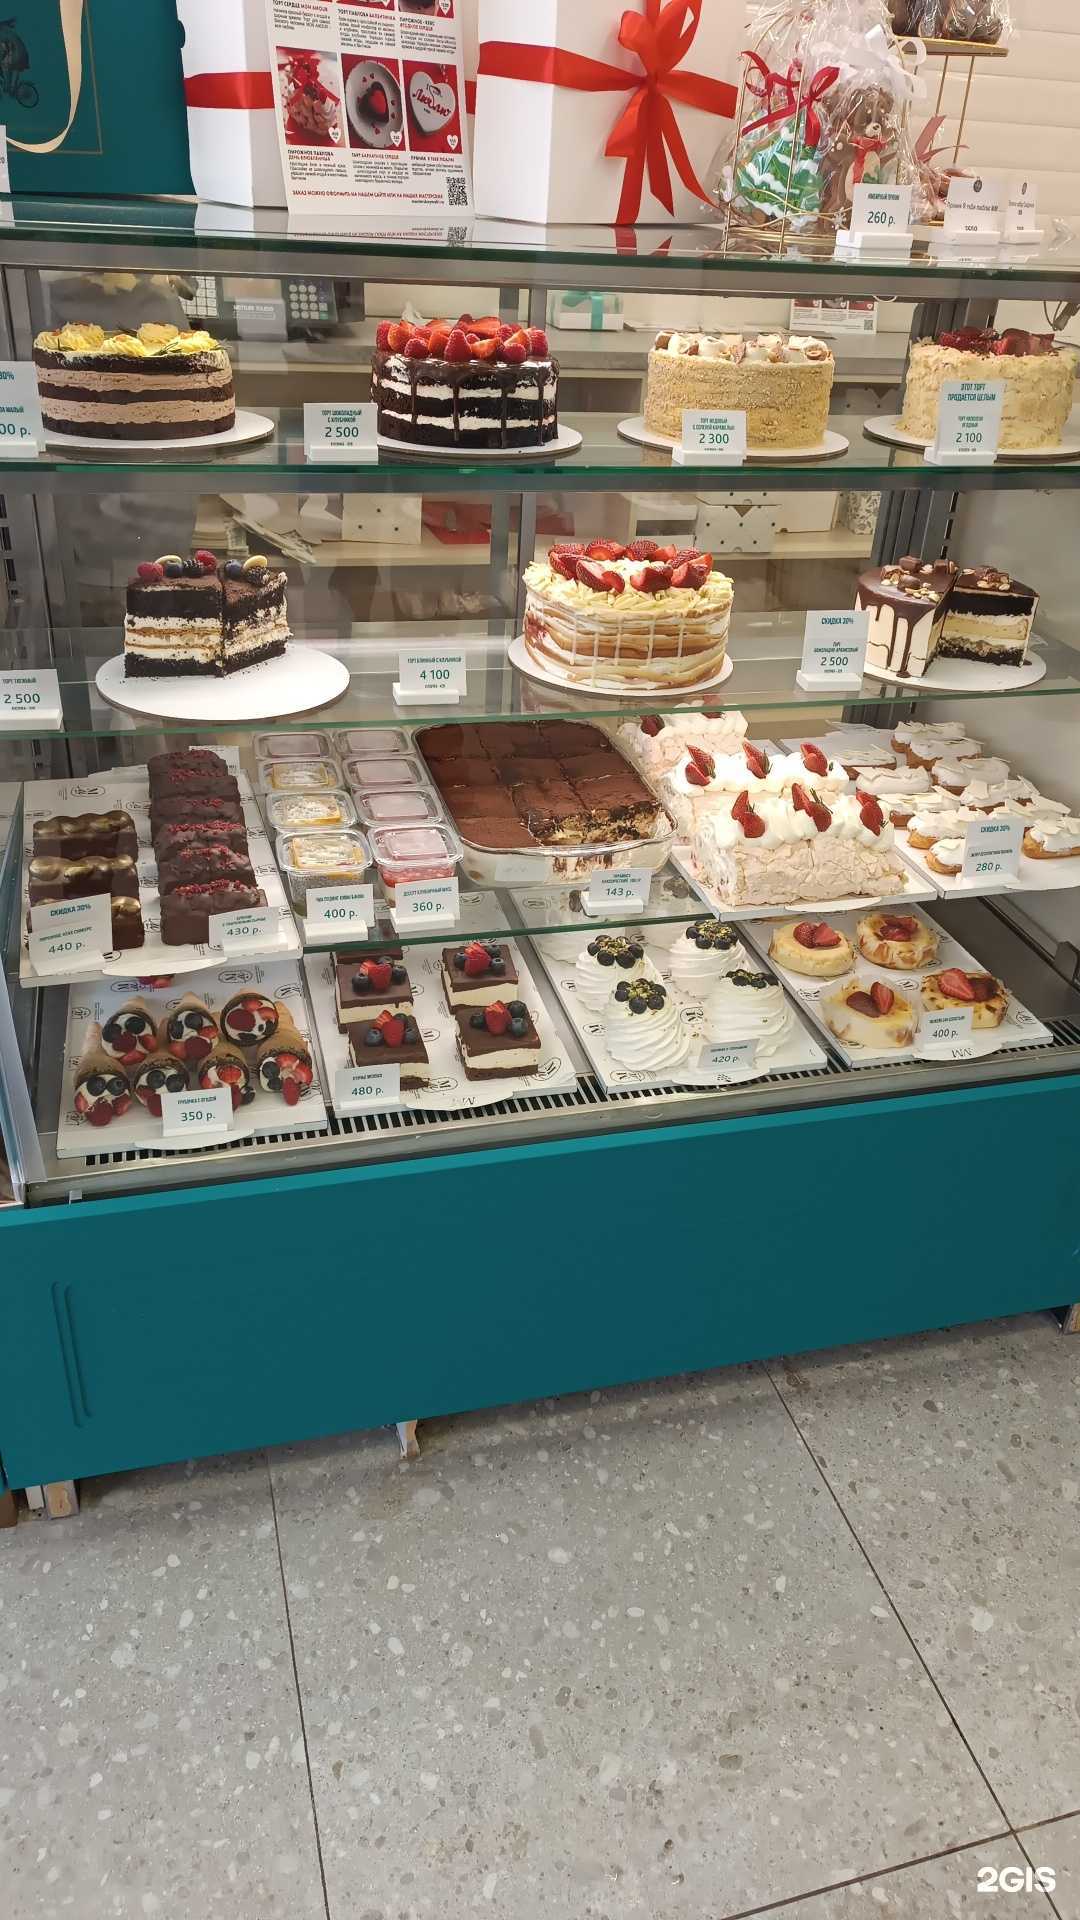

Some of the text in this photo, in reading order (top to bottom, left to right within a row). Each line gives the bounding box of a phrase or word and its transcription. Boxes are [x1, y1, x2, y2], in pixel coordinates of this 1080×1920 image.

[867, 211, 896, 227] 260 р.
[20, 427, 31, 438] р.
[976, 862, 993, 872] 280
[606, 887, 624, 896] 143
[412, 901, 433, 912] 360
[324, 908, 346, 919] 400
[227, 926, 249, 936] 430
[48, 942, 73, 954] 440
[932, 1028, 950, 1038] 400
[712, 1055, 731, 1063] 420
[351, 1086, 373, 1096] 480
[180, 1110, 203, 1122] 350
